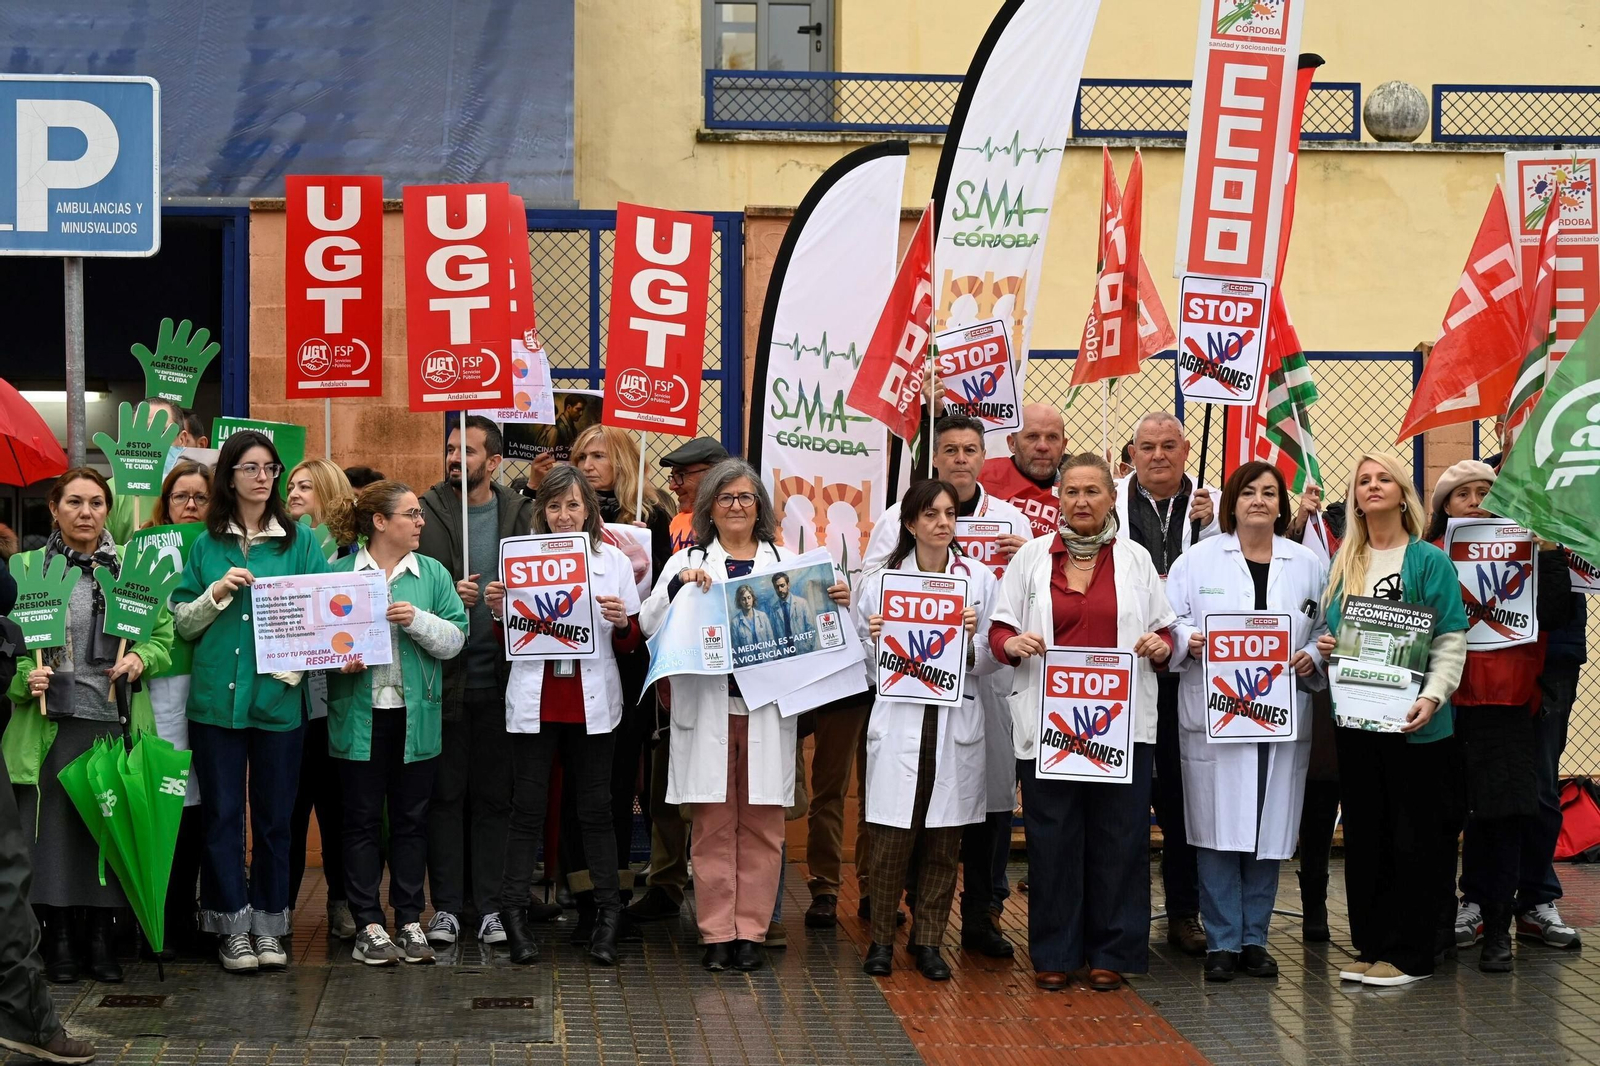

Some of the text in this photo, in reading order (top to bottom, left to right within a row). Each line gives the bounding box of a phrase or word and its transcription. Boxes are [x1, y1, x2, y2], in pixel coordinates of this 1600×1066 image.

[1235, 24, 1281, 36] CÓRDOBA
[1208, 41, 1234, 50] sanidad
[1241, 43, 1287, 53] sociosanitario
[17, 99, 119, 232] P
[1203, 62, 1268, 265] CCOO
[56, 202, 143, 215] AMBULANCIAS Y
[952, 178, 1030, 229] SMA
[61, 222, 137, 234] MINUSVALIDOS
[1558, 218, 1591, 226] RDOBA
[953, 226, 1039, 248] CÓRDOBA
[304, 186, 362, 334] UGT
[426, 194, 490, 345] UGT
[630, 216, 692, 368] UGT
[1188, 298, 1254, 323] STOP
[303, 345, 327, 360] UGT
[334, 346, 354, 357] FSP
[1207, 332, 1242, 363] NO
[150, 361, 198, 373] AGRESIONES
[163, 355, 188, 364] #STOP
[426, 357, 453, 372] UGT
[462, 356, 483, 367] FSP
[940, 343, 999, 375] STOP
[167, 376, 187, 384] CUIDA
[1179, 352, 1253, 391] AGRESIONES
[621, 374, 647, 390] UGT
[654, 380, 674, 392] FSP
[962, 371, 997, 404] NO
[159, 392, 182, 401] SATSE
[771, 377, 852, 433] SMA
[497, 411, 538, 419] RESPÉTAME
[219, 425, 229, 439] LA
[519, 443, 554, 453] MEDICINA
[776, 427, 869, 456] CÓRDOBA
[115, 449, 162, 458] AGRESIONES
[1009, 496, 1058, 523] COO
[955, 540, 998, 562] TOP
[1468, 542, 1516, 560] STOP
[511, 558, 576, 584] STOP
[125, 581, 150, 593] #STOP
[1476, 561, 1525, 605] NO
[13, 599, 62, 610] GRESIONES
[20, 592, 49, 601] #STOP
[112, 587, 158, 605] AGRESIONES
[119, 603, 147, 615] TE CUIDA
[535, 590, 573, 621] NO
[888, 595, 955, 621] STOP
[1372, 604, 1411, 615] MEDICAMENTO
[1421, 611, 1433, 619] USO
[1463, 600, 1529, 629] GRESIONES
[1346, 607, 1431, 628] RECOMENDADO
[1356, 616, 1377, 624] CUANDO
[1406, 625, 1429, 634] ENFERMO
[117, 623, 141, 635] SATSE
[508, 615, 590, 643] AGRESIONES
[24, 634, 52, 643] SATSE
[738, 640, 777, 653] MEDICINA
[778, 636, 788, 646] ES
[908, 630, 945, 663] NO
[1214, 635, 1280, 658] STOP
[306, 653, 363, 665] RESPÉTAME
[739, 645, 796, 663] VIOLENCIA NO
[879, 651, 957, 690] AGRESIONES
[1340, 667, 1401, 683] RESPETO
[1052, 671, 1120, 696] STOP
[1235, 667, 1272, 700] NO
[1208, 692, 1288, 726] AGRESIONES
[1073, 705, 1111, 739] NO
[1041, 728, 1124, 767] AGRESIONES
